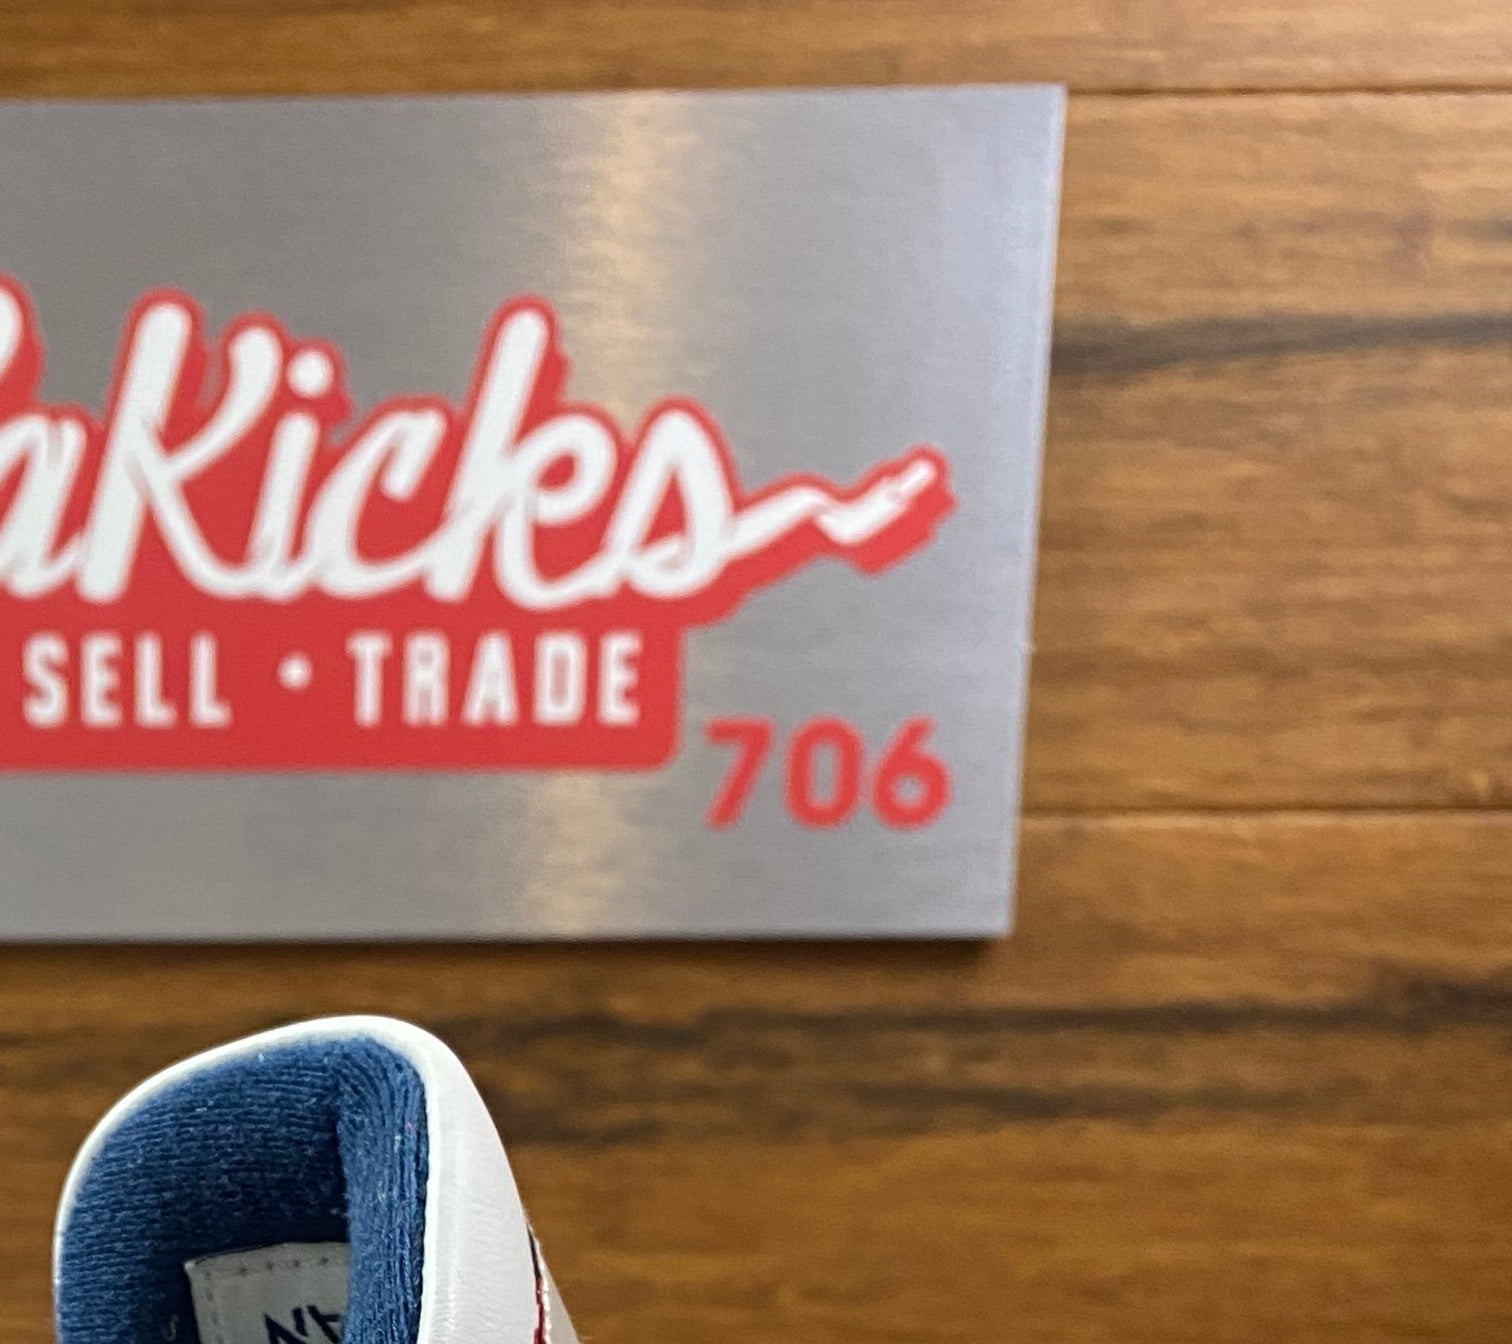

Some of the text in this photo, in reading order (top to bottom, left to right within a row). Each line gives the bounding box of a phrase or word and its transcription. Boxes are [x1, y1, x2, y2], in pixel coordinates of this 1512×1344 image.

[21, 630, 234, 730] SELL
[345, 629, 644, 730] TRADE
[703, 715, 956, 833] 706
